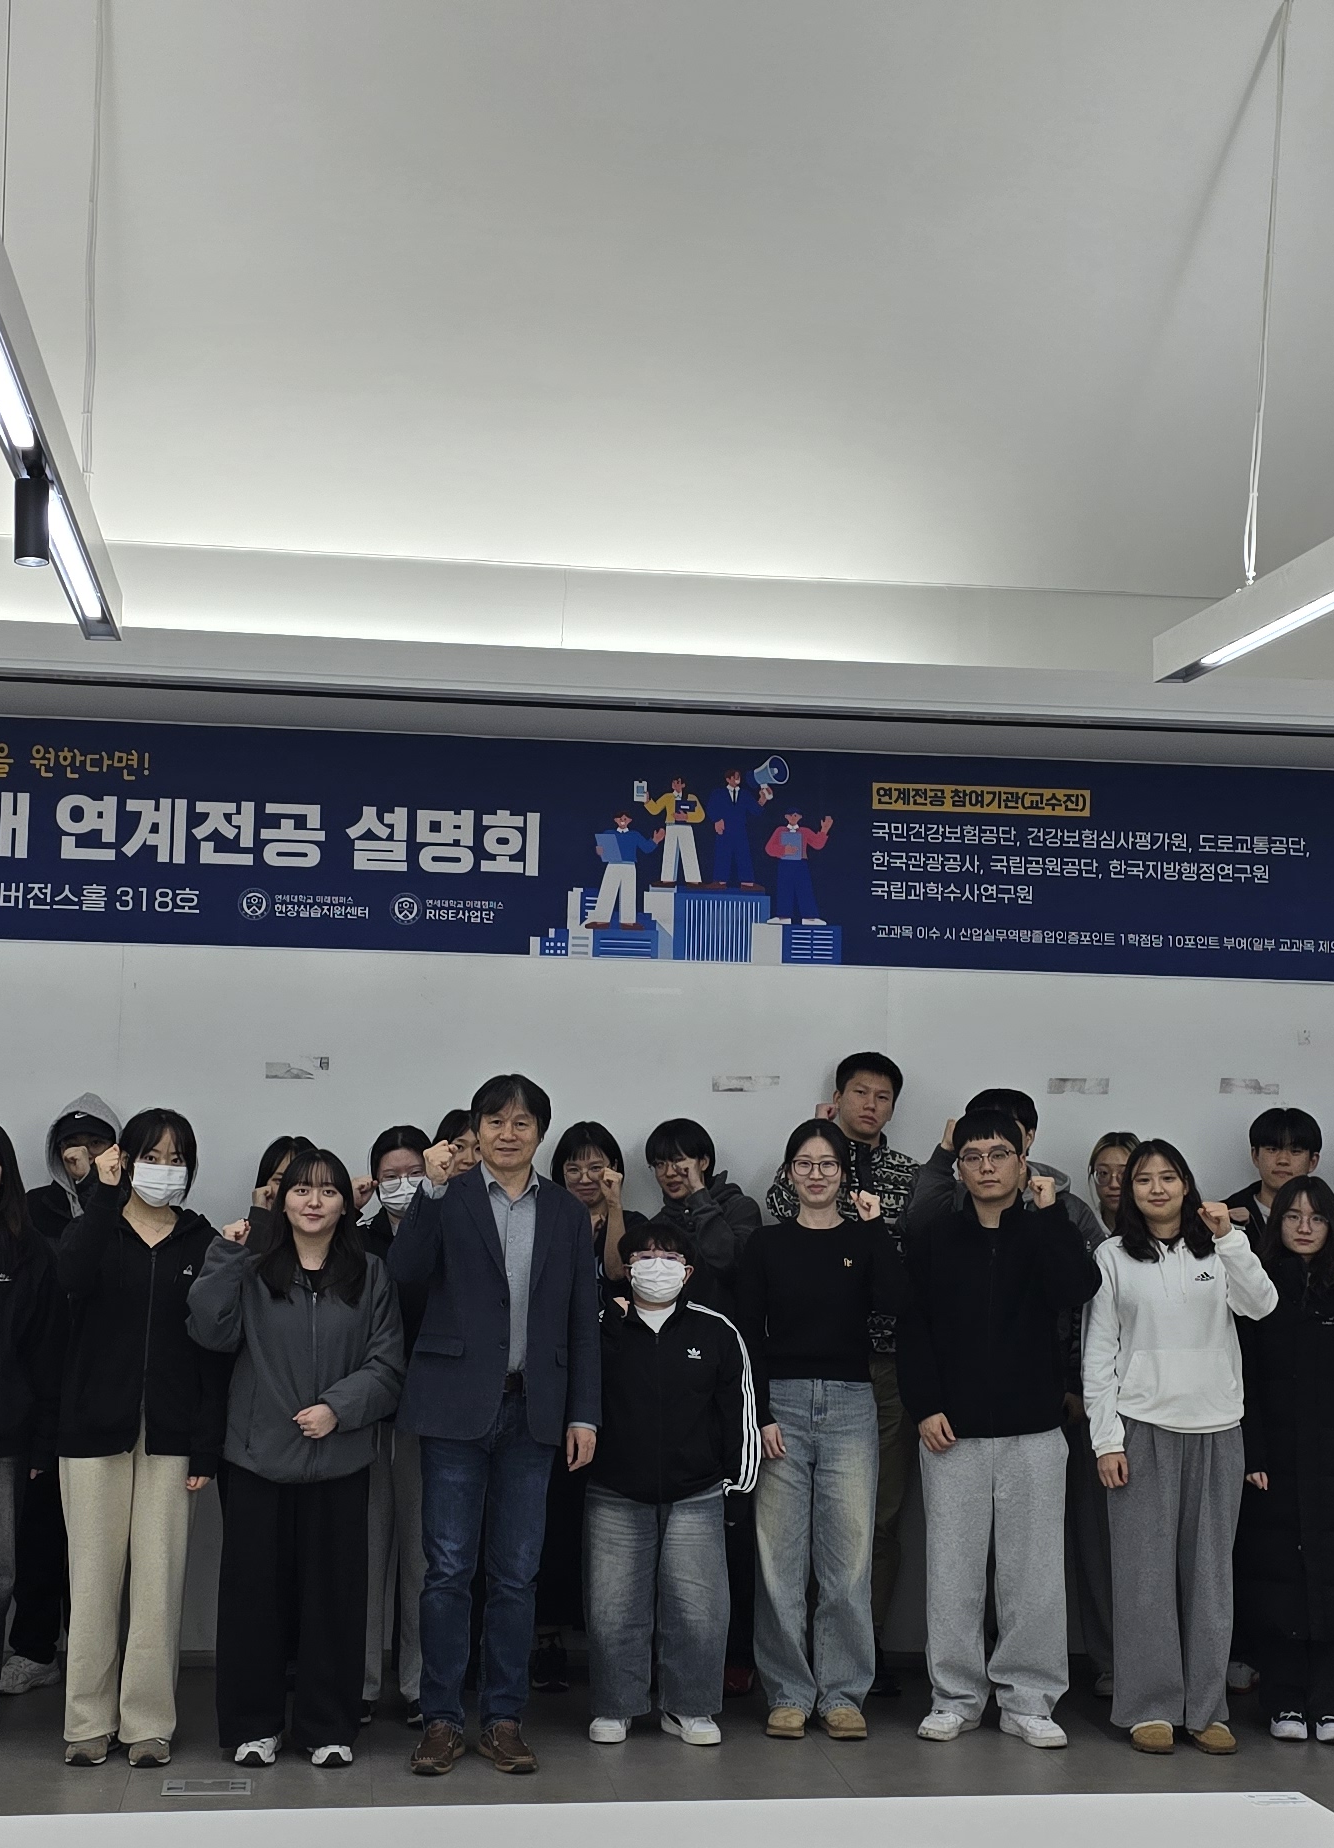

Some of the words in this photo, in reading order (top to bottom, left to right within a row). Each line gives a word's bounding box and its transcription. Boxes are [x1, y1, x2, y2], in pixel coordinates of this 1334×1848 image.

[30, 744, 150, 780] 원한다면!
[876, 786, 946, 808] 연계전공
[950, 788, 1087, 812] 참여기관(교수진)
[56, 794, 325, 868] 연계전공
[345, 805, 541, 877] 설명회
[872, 822, 1021, 848] 국민건강보험공단,
[1027, 828, 1192, 853] 건강보험심사평가원,
[1198, 833, 1310, 858] 도로교통공단,
[871, 851, 985, 875] 한국관광공사,
[989, 855, 1103, 879] 국립공원공단,
[1108, 859, 1270, 884] 한국지방행정연구원
[115, 887, 200, 914] 318호
[274, 894, 314, 904] 연세대학교
[870, 880, 1034, 905] 국립과학수사연구원
[274, 904, 369, 920] 현장실습지원센터
[425, 909, 495, 924] RISE사업단
[917, 926, 941, 941] 이수
[944, 927, 956, 941] 시
[958, 928, 1116, 945] 산업실무역량졸업인증포인트
[1119, 933, 1164, 948] 1학점당
[1167, 935, 1221, 950] 10포인트
[1223, 936, 1276, 952] 부여(일부
[1278, 938, 1316, 953] 교과목
